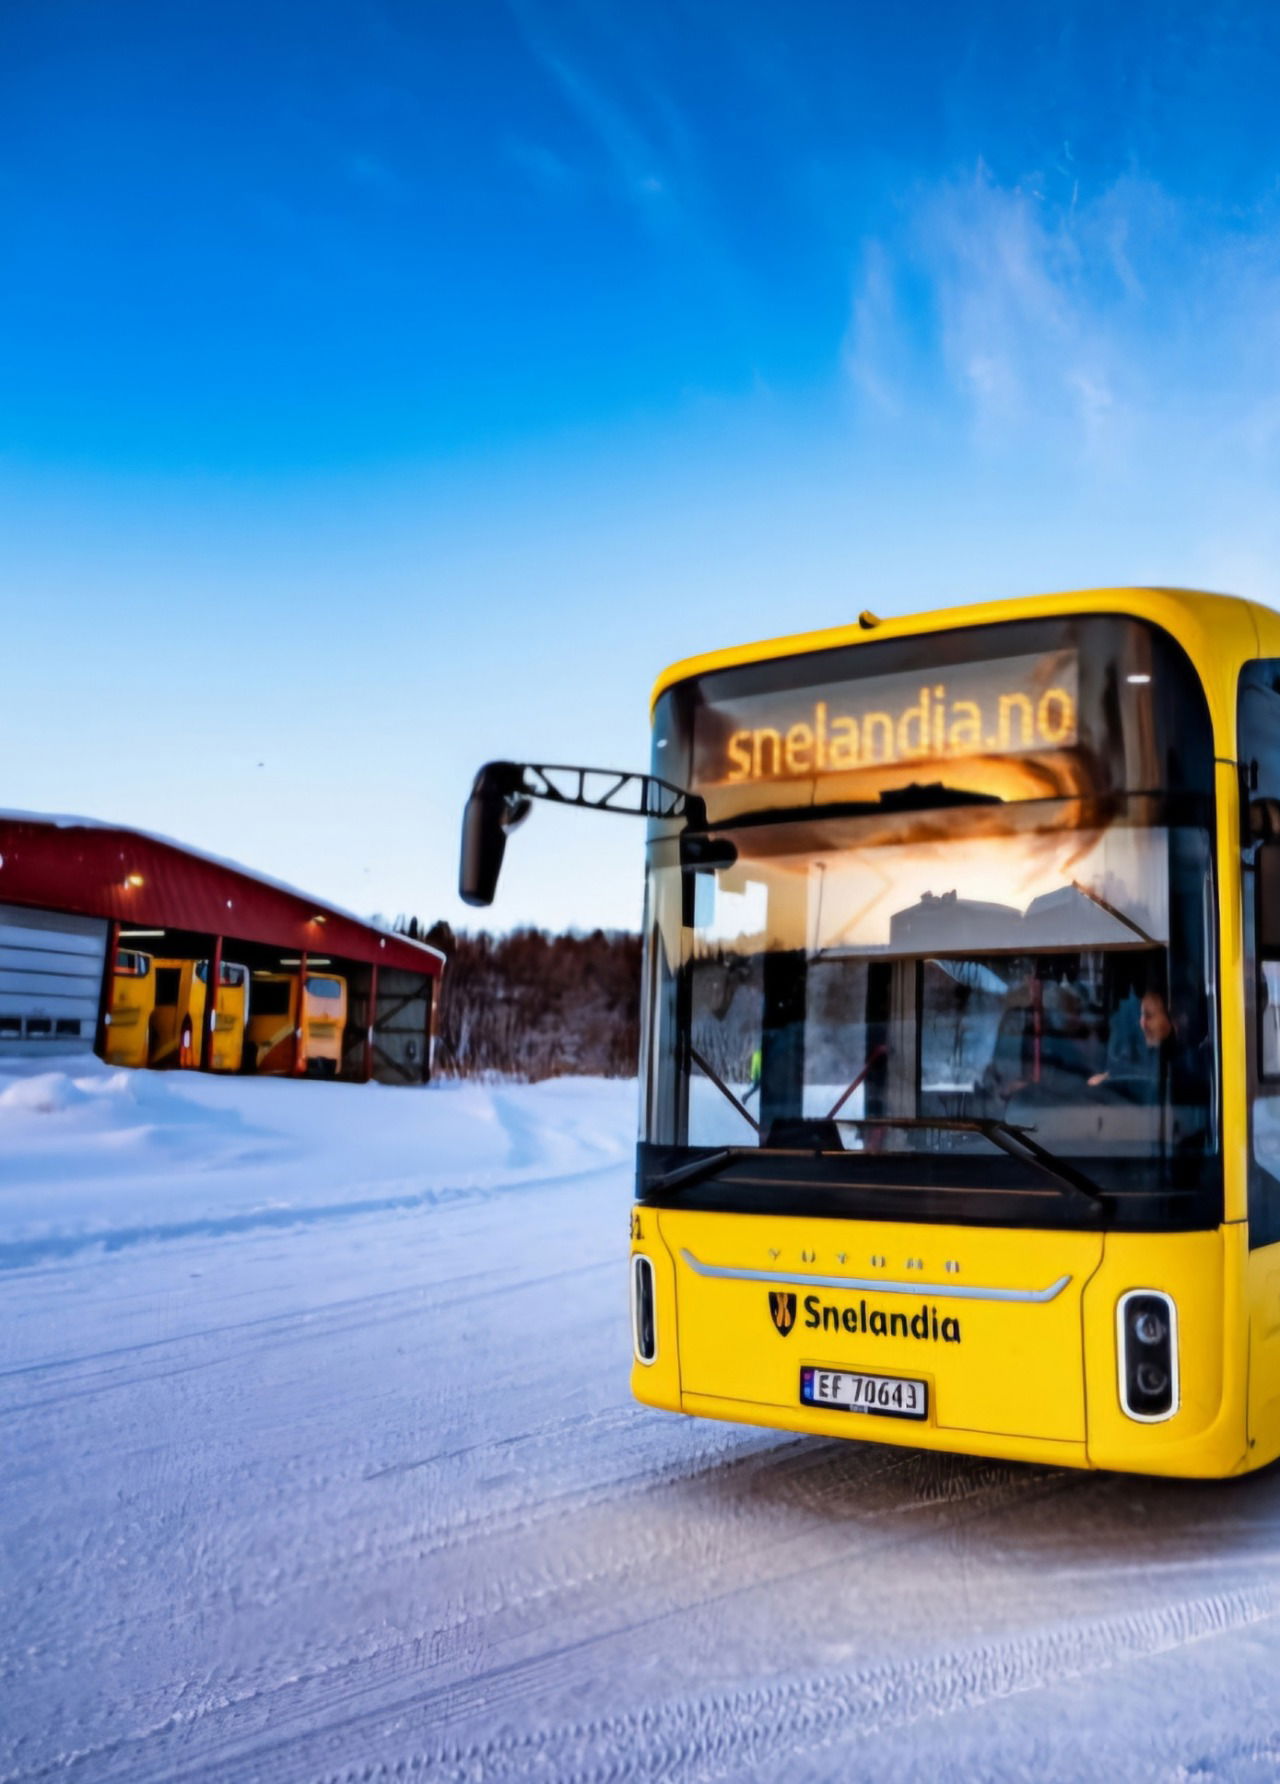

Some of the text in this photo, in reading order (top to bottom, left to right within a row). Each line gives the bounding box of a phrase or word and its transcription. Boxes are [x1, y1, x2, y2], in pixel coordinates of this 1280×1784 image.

[727, 684, 1074, 780] snelandia.no
[803, 1295, 962, 1344] Snelandia
[818, 1374, 918, 1409] EF 70643
